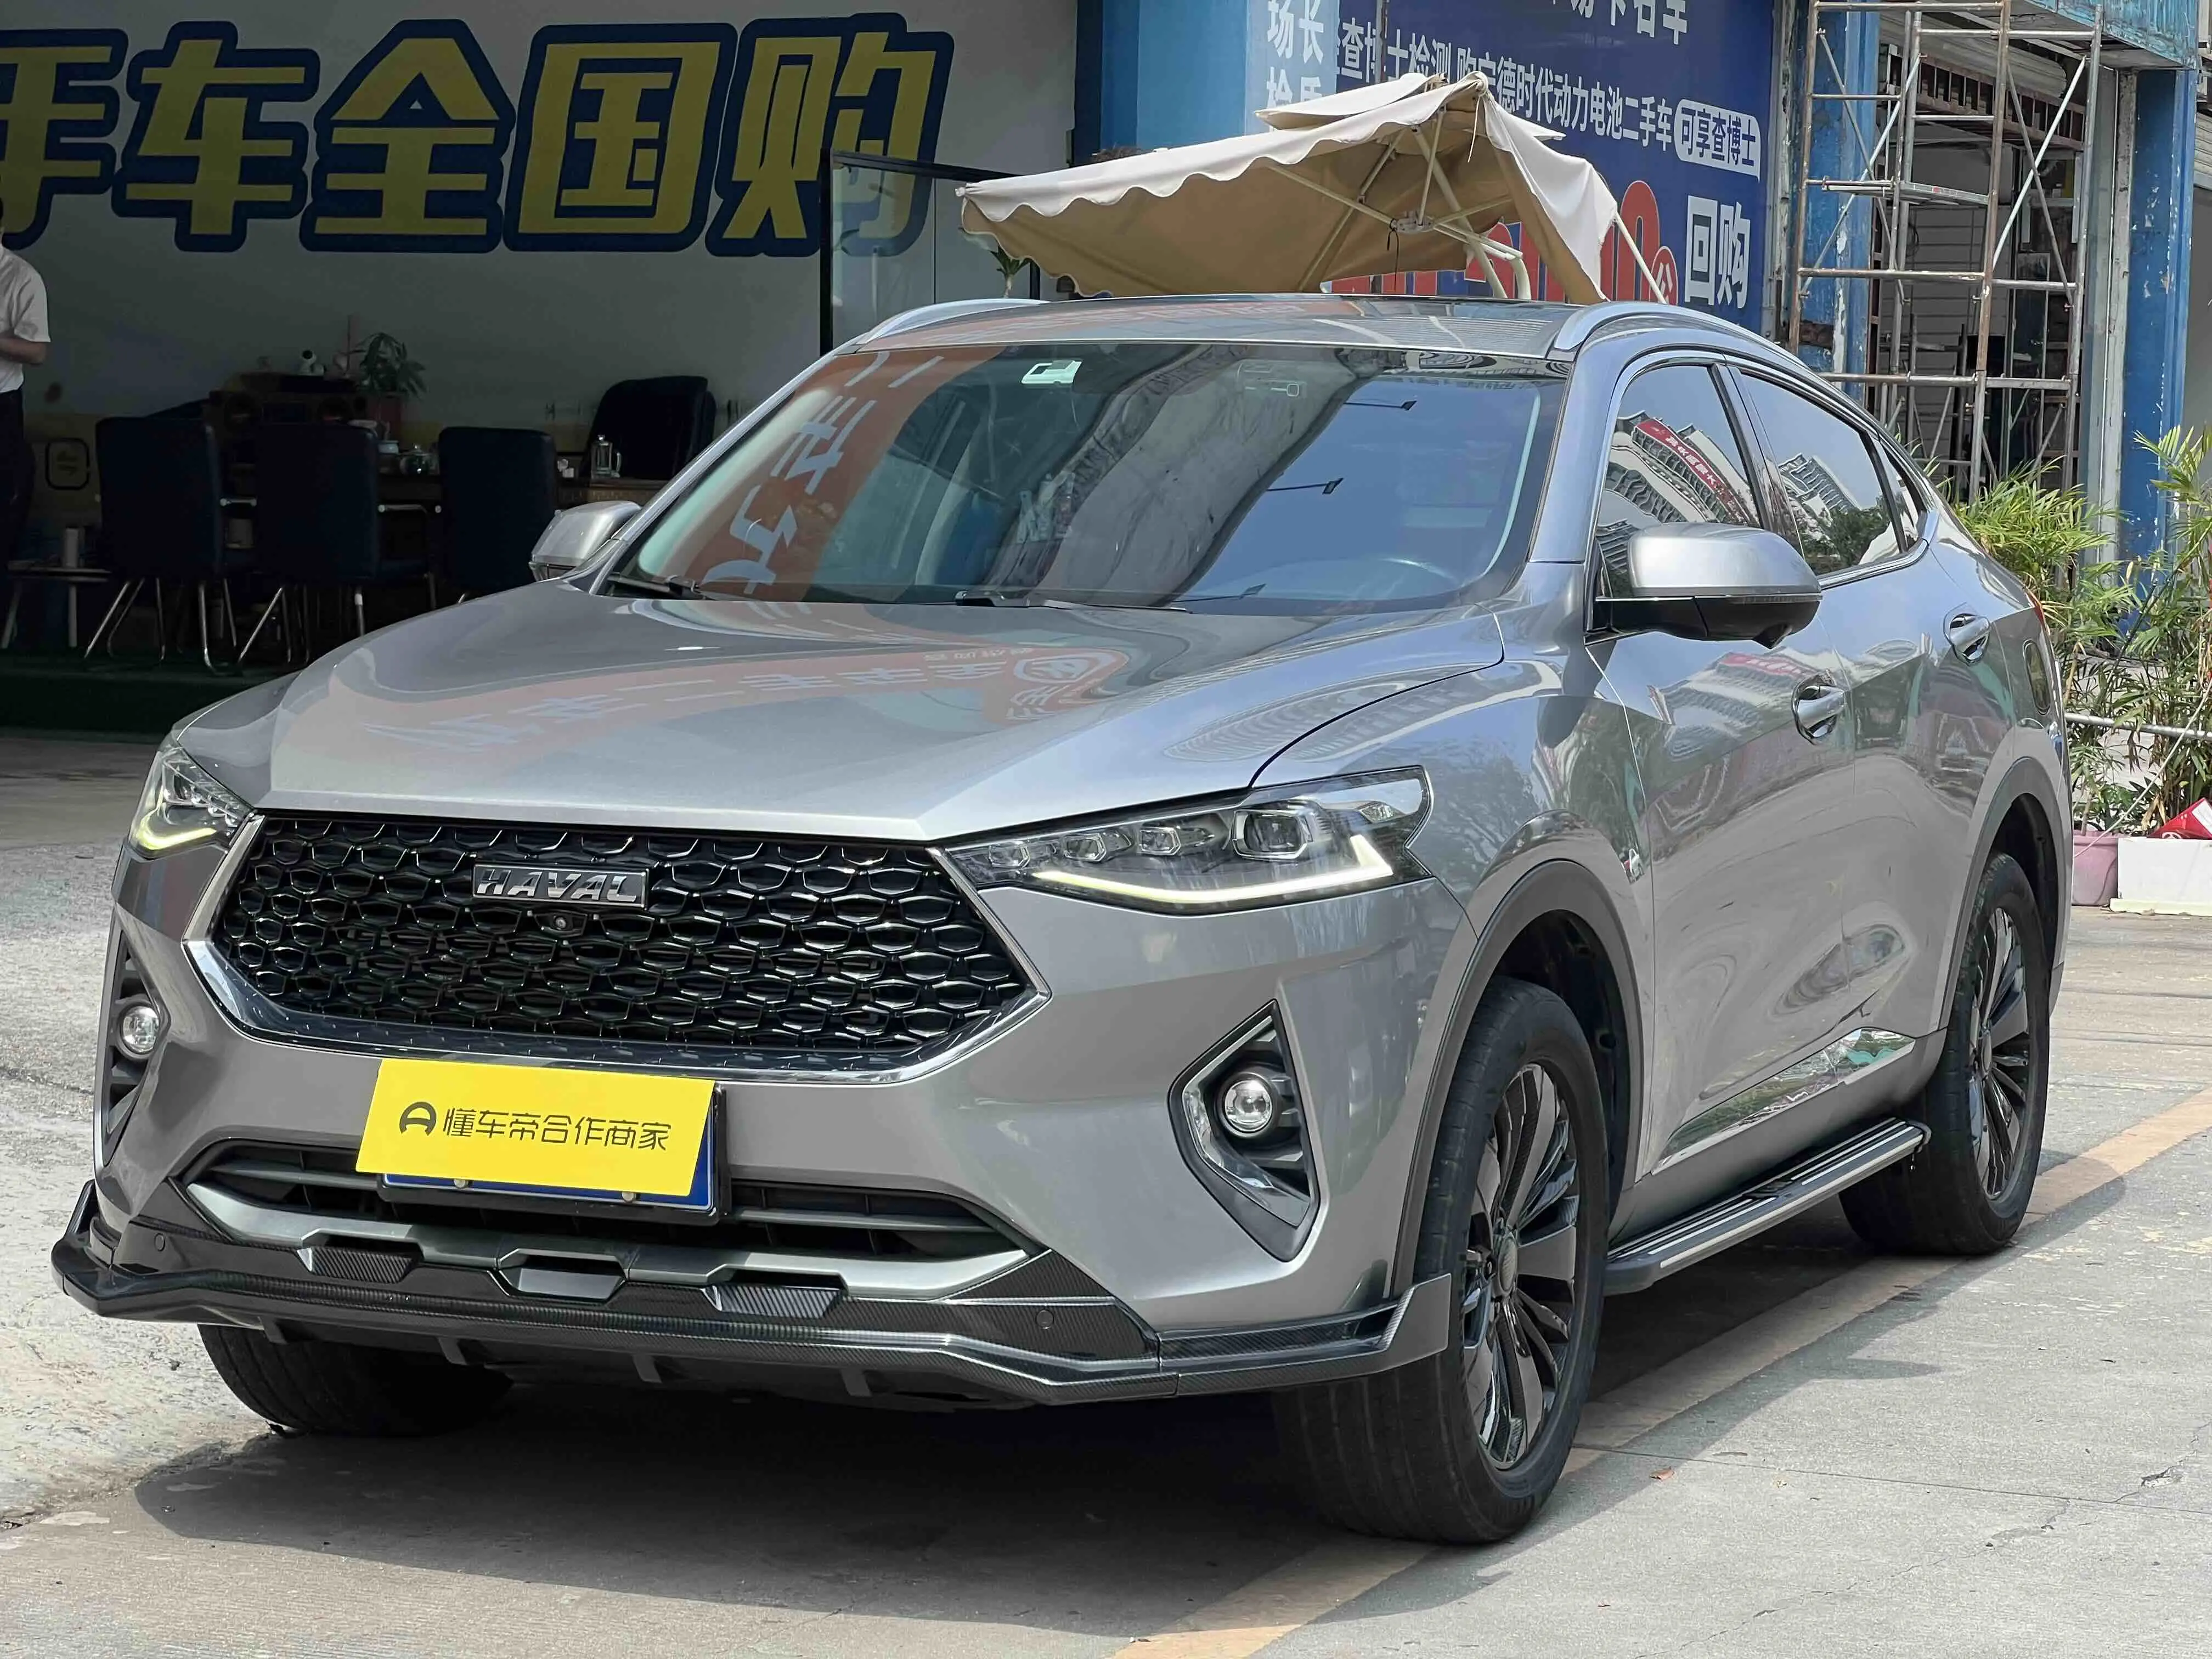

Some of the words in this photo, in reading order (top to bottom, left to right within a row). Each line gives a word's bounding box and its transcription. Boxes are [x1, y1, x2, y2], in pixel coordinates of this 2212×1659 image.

[1680, 106, 1757, 166] 可享查博士
[1684, 194, 1751, 308] 回购
[476, 868, 637, 903] HAVAL
[443, 1107, 672, 1151] 懂车帝合作商家
